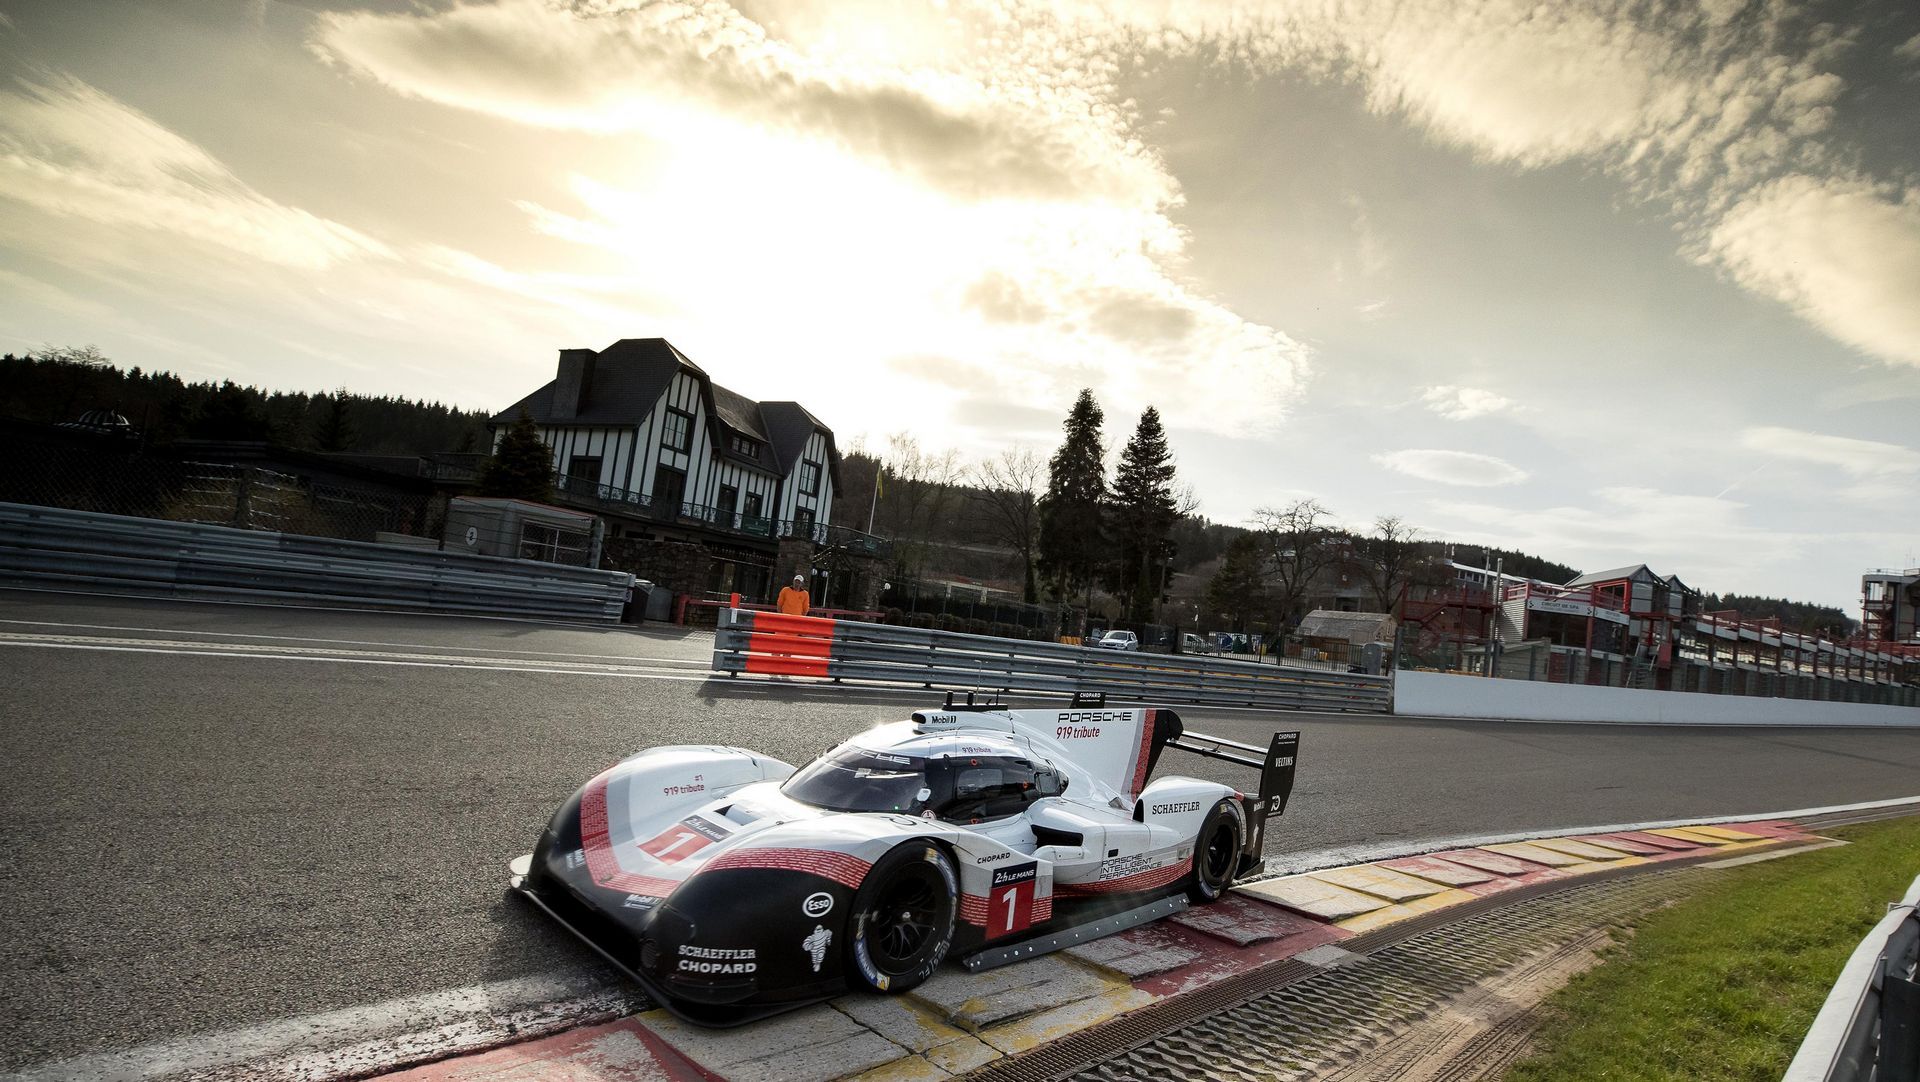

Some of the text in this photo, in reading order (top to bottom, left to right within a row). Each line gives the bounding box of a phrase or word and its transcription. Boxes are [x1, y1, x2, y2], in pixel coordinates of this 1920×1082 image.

[1058, 712, 1132, 723] PORSCHE
[1057, 726, 1100, 739] 919 tribute
[1275, 756, 1293, 767] VELTINS
[664, 784, 704, 796] 919 tribute
[1152, 802, 1200, 815] SCHAEFFLER
[653, 832, 697, 857] 1
[977, 852, 1011, 864] CHOPARD
[1101, 853, 1143, 867] PORSCHE
[1099, 861, 1162, 880] PERFORMANCE
[1100, 857, 1152, 874] INTELLIGENT
[1016, 869, 1034, 879] MANS
[808, 899, 829, 911] Esso
[1002, 888, 1017, 931] 1
[678, 945, 756, 960] SCHAEFFLER
[678, 960, 757, 974] CHOPARD
